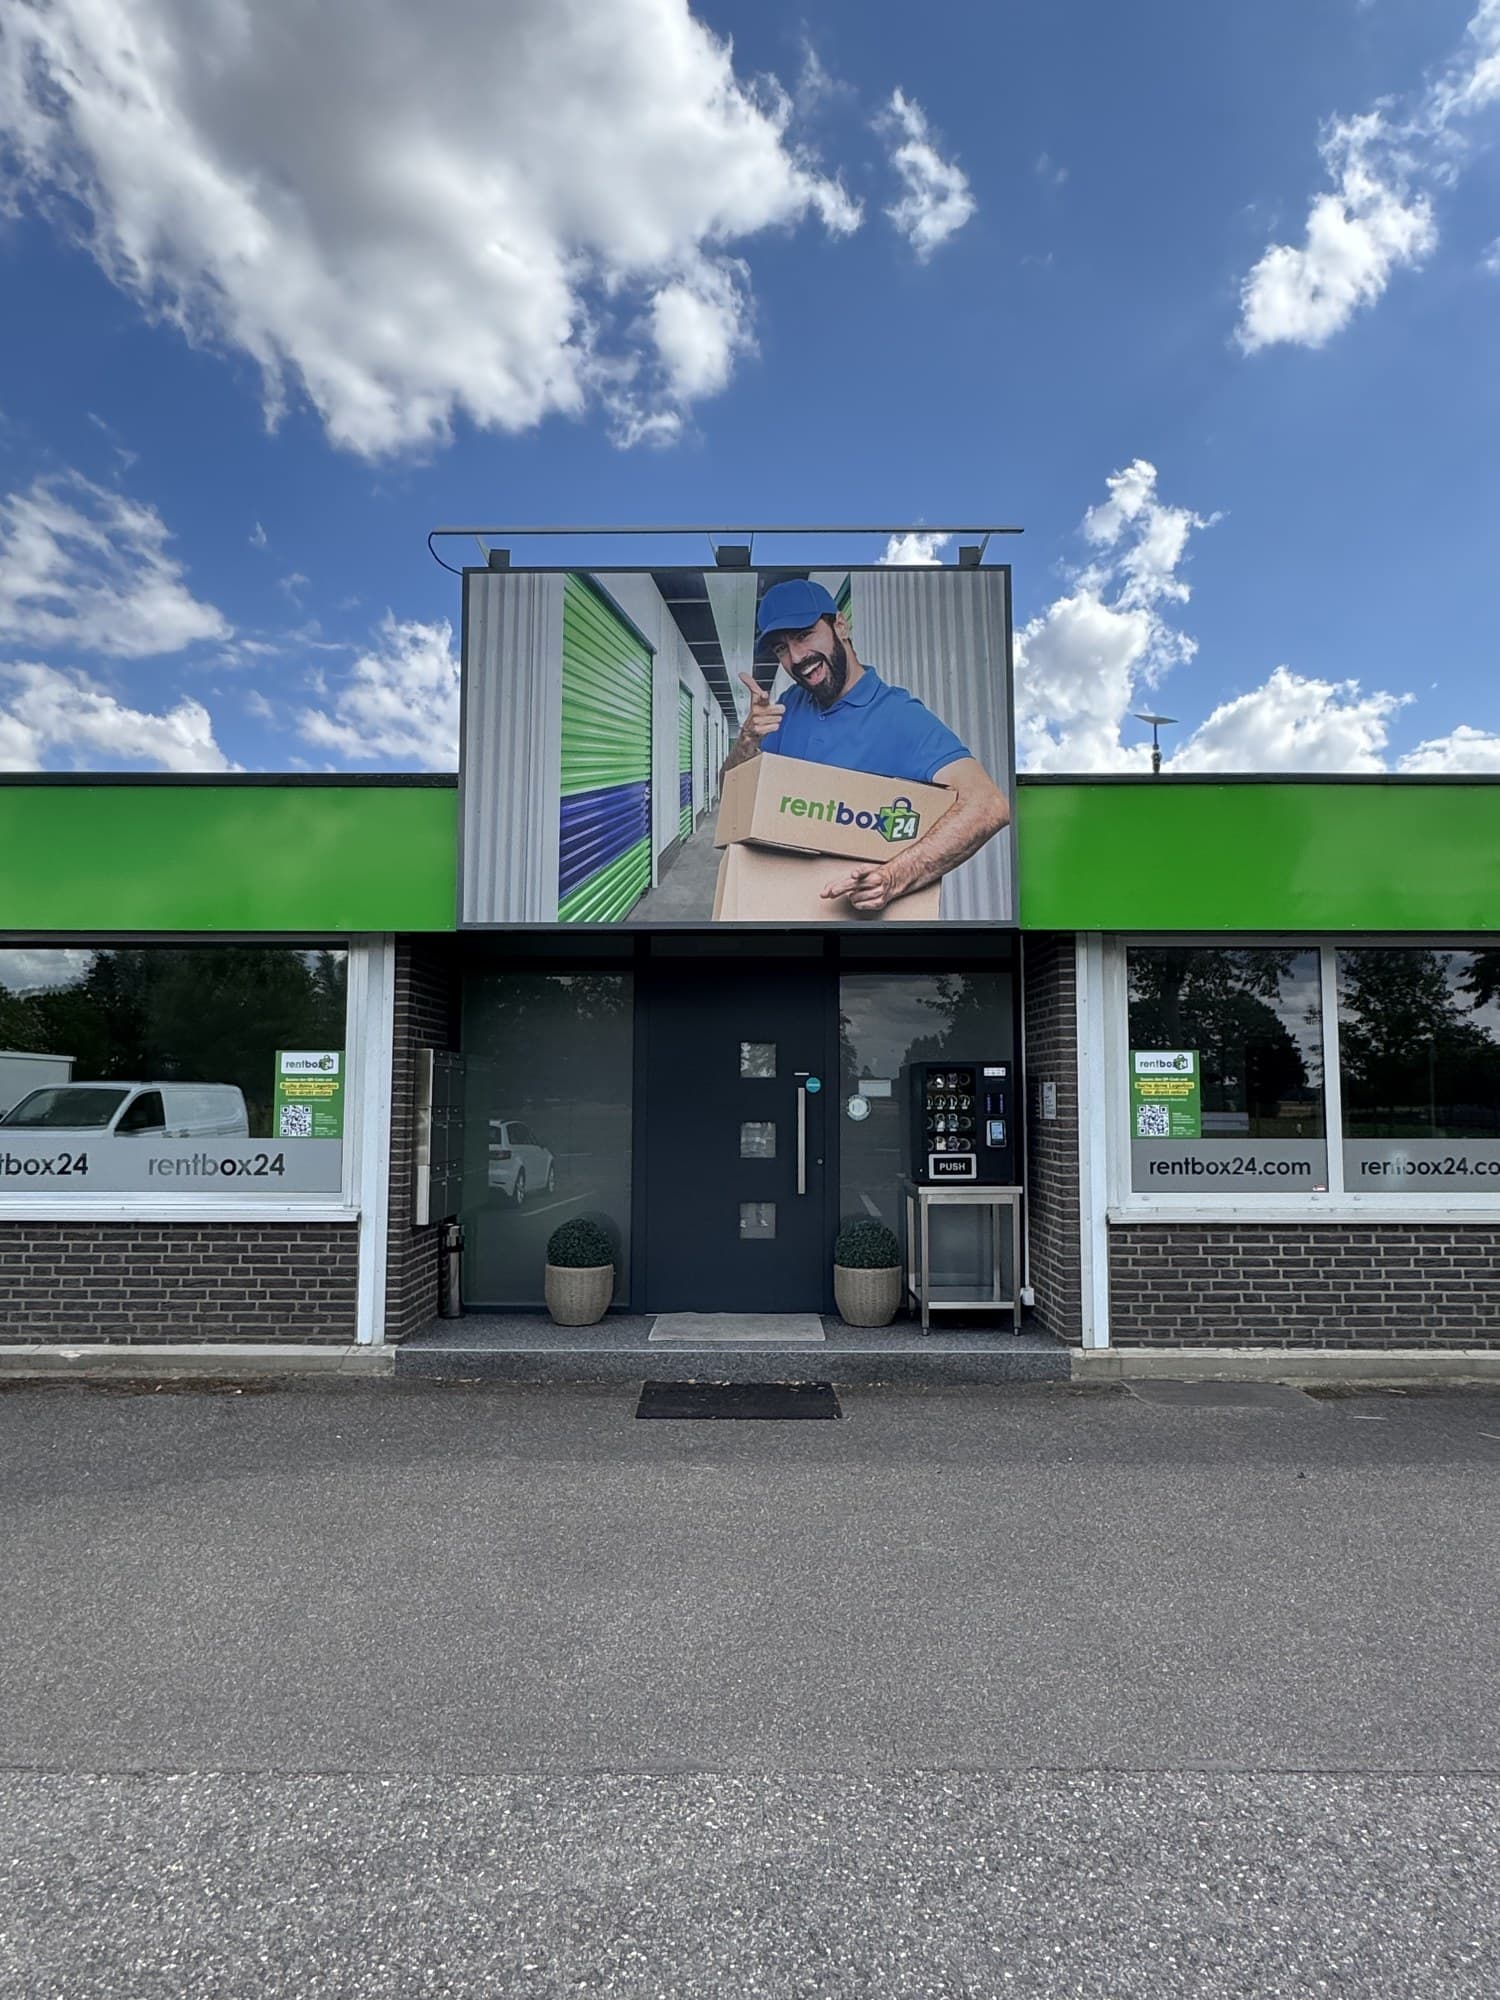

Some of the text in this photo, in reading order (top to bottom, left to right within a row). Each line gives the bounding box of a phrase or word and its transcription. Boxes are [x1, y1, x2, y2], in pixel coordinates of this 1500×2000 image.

[779, 796, 916, 838] rentbox 24
[148, 1153, 286, 1177] rentbox24
[939, 1162, 966, 1172] PUSH
[1149, 1157, 1311, 1176] rentbox24.com
